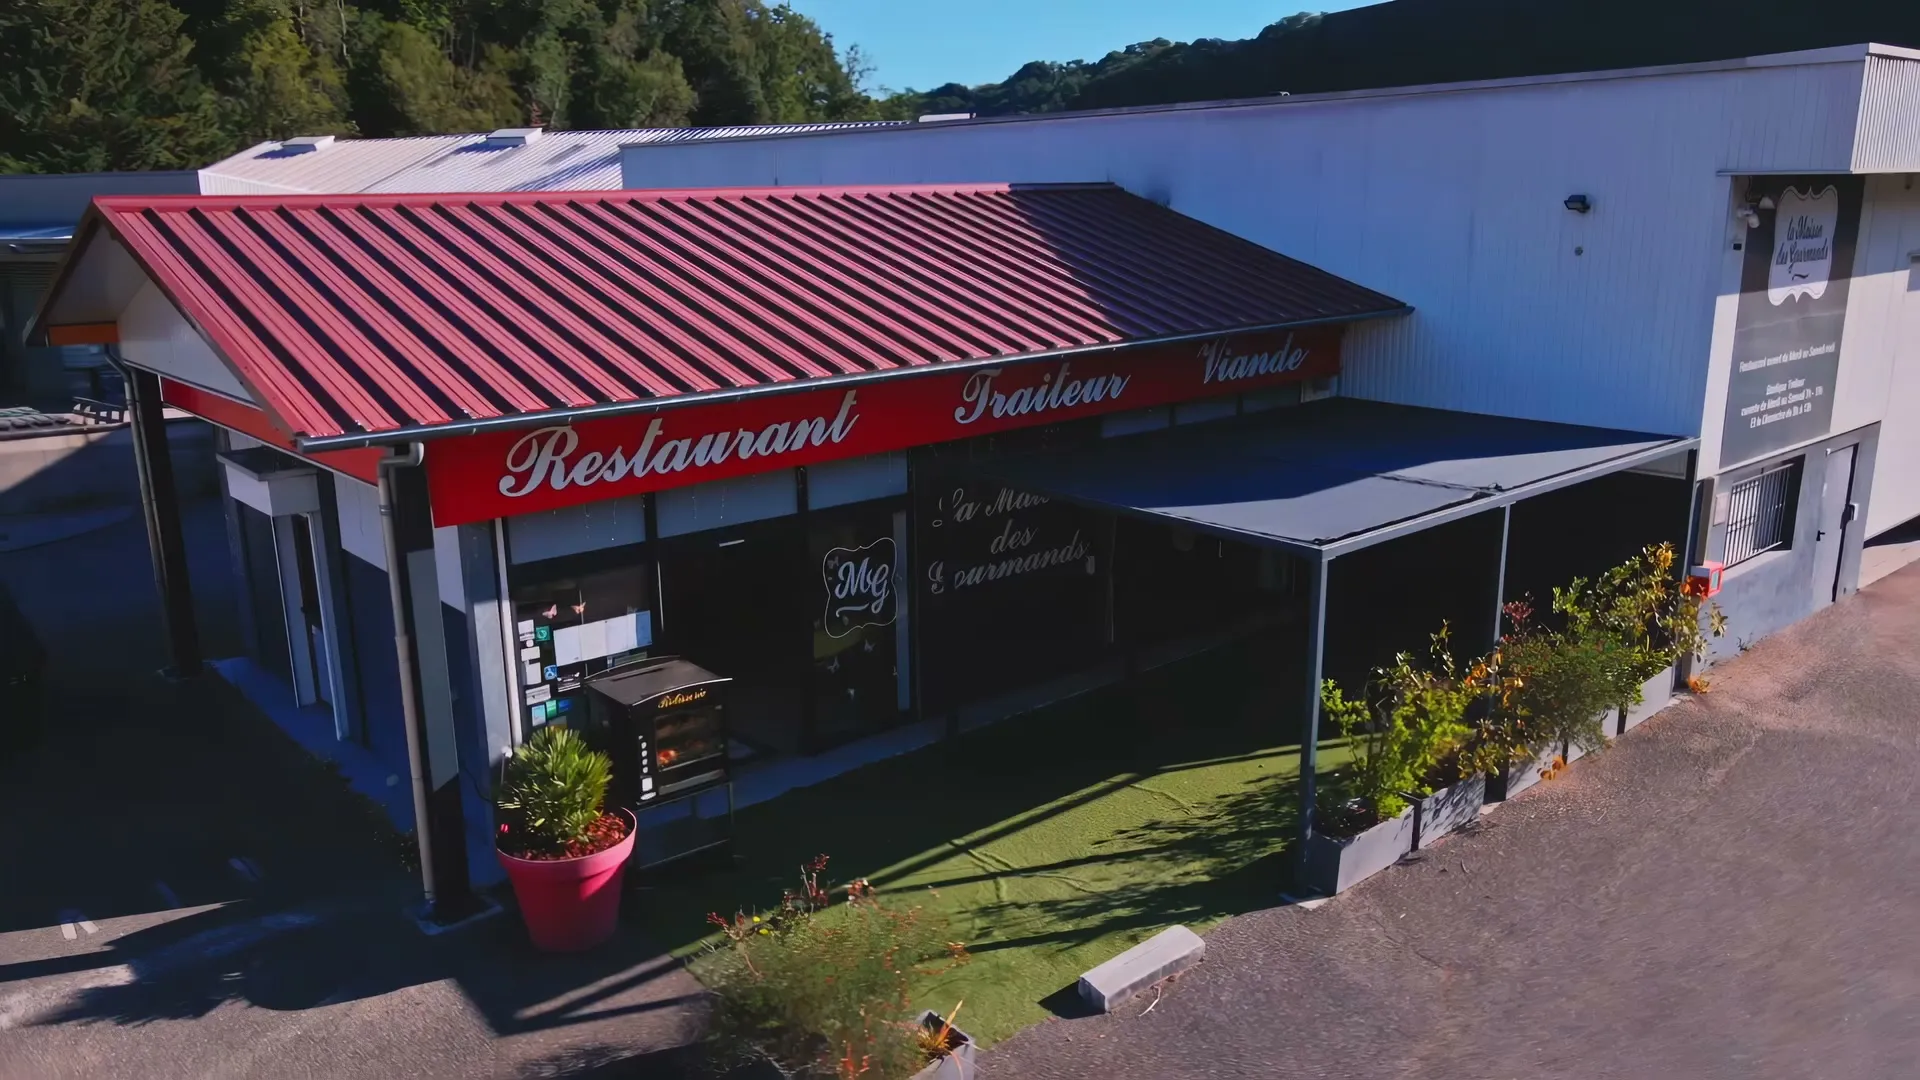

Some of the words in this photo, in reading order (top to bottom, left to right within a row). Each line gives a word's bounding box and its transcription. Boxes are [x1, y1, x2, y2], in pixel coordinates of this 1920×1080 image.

[1795, 215, 1823, 241] Maison
[1776, 242, 1788, 265] des
[1788, 237, 1829, 274] Gourmands
[499, 390, 860, 498] Restaurant
[954, 362, 1131, 425] Traiteur
[1197, 332, 1310, 384] Viande
[990, 518, 1039, 554] des
[835, 557, 890, 614] MG
